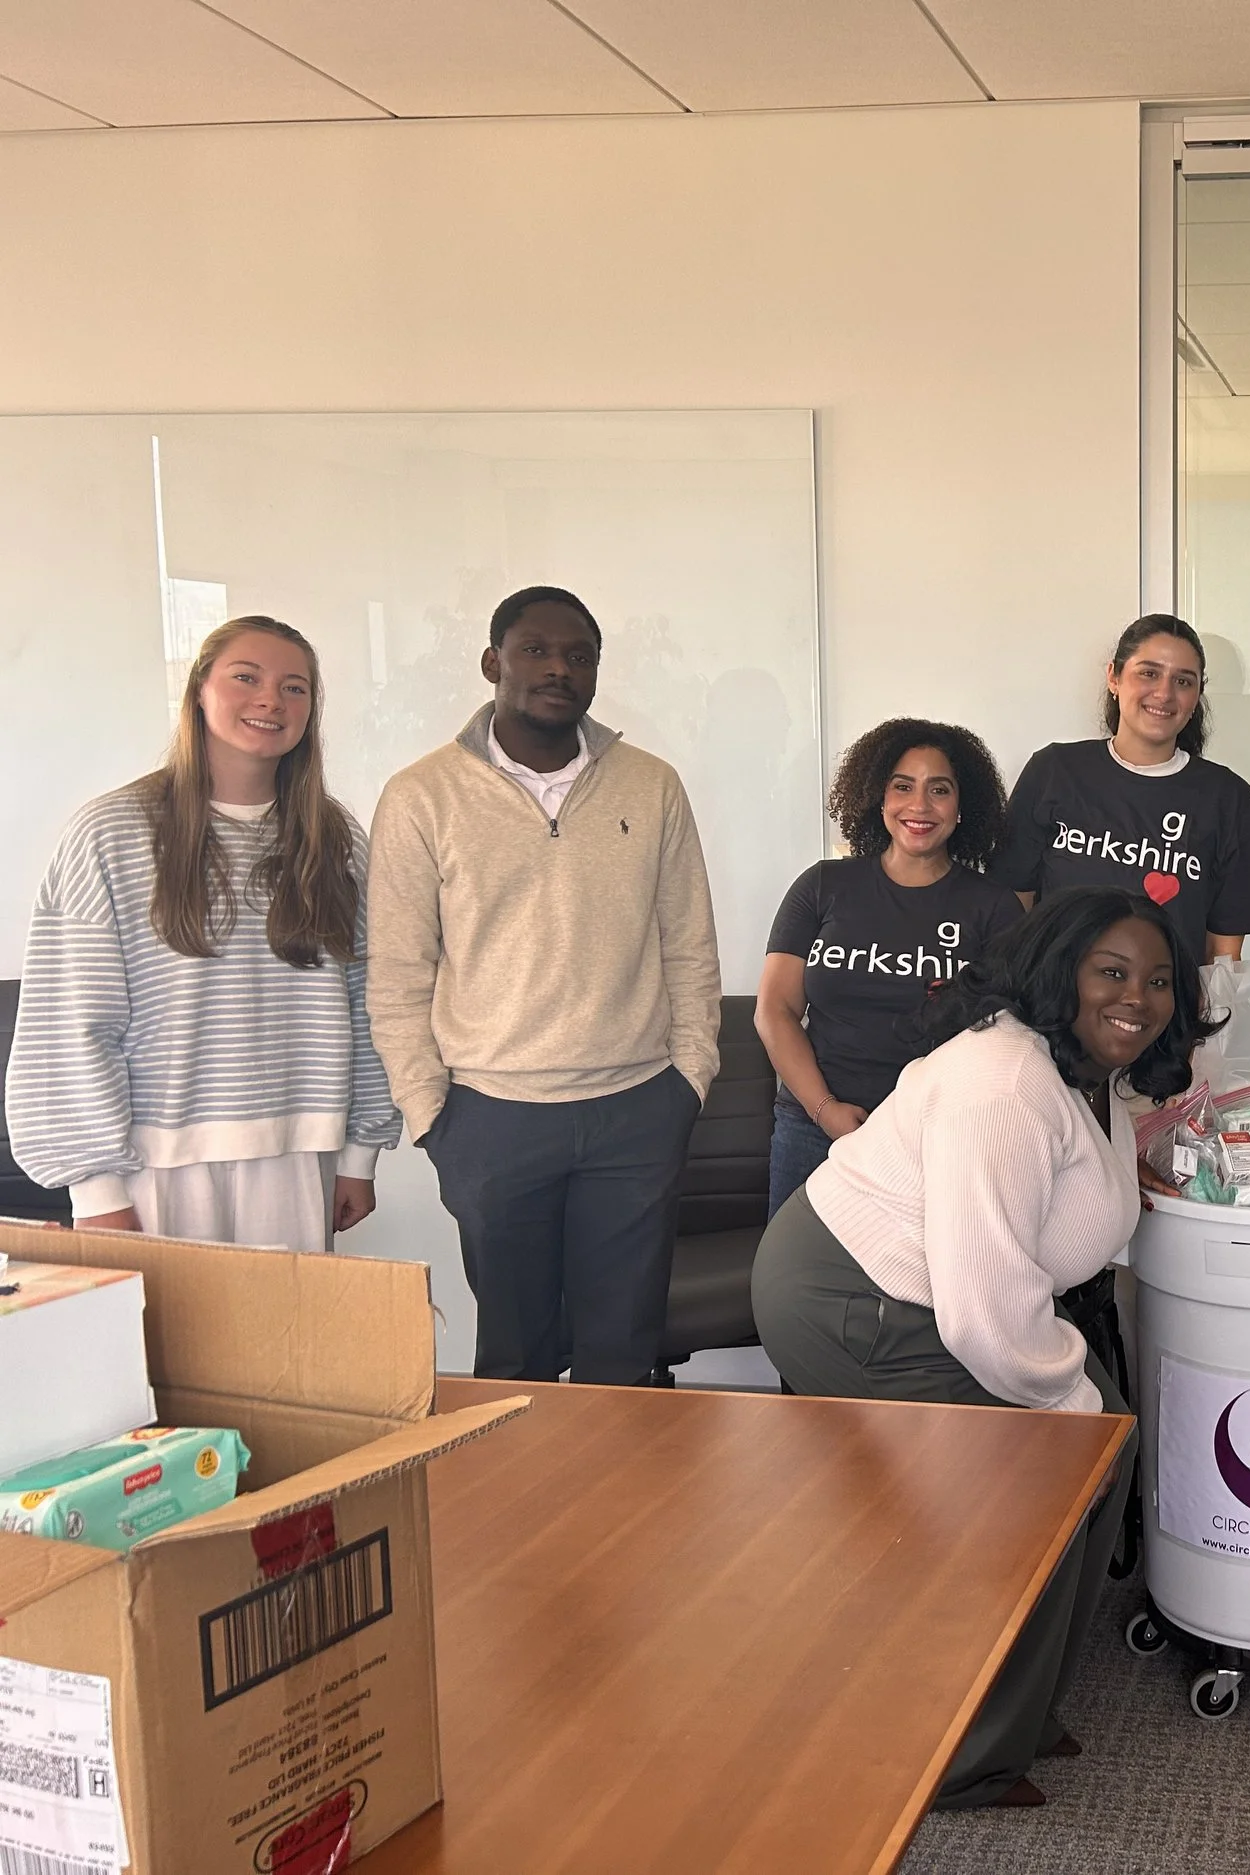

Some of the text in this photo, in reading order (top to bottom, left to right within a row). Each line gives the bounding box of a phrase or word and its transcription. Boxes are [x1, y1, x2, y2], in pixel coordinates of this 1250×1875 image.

[1162, 811, 1185, 841] g
[1052, 821, 1201, 881] Berkshire
[938, 921, 960, 948] g
[807, 938, 970, 980] Berkshir
[352, 1728, 385, 1756] FISHER
[286, 1755, 317, 1779] HARD
[323, 1745, 351, 1771] PRICE
[258, 1767, 321, 1811] FRAGRANCE
